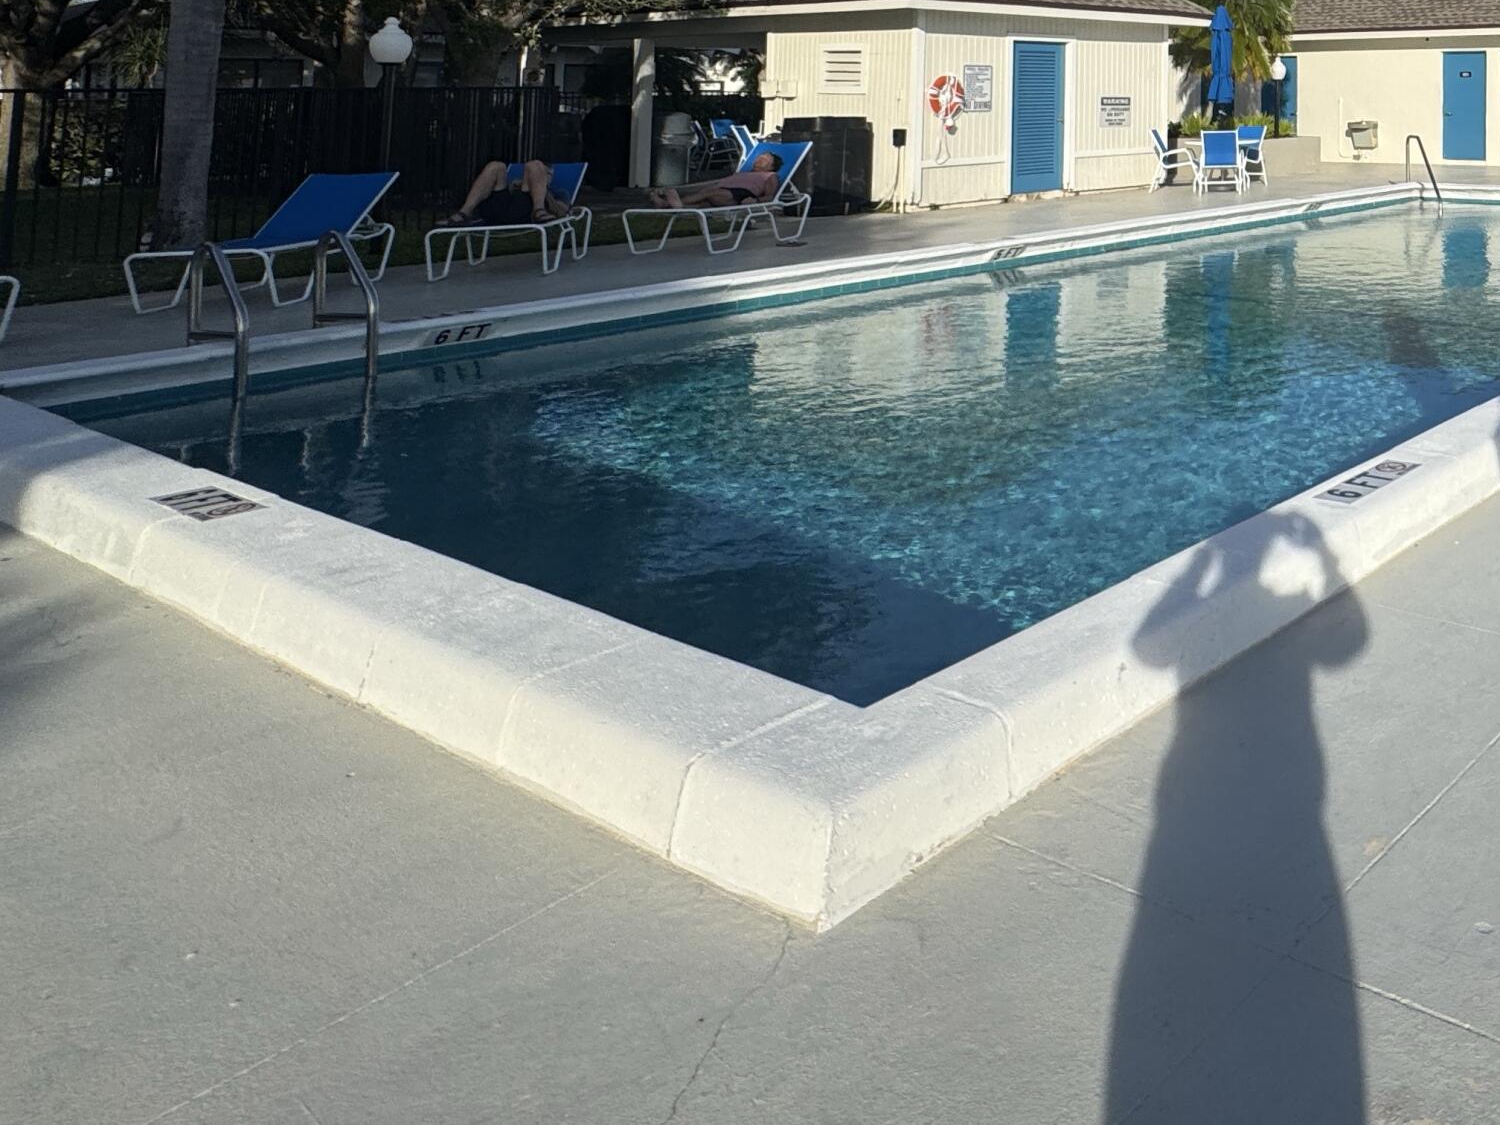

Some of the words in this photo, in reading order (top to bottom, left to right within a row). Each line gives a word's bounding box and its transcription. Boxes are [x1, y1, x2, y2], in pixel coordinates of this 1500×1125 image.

[434, 329, 451, 345] 6
[456, 322, 493, 342] FT
[1343, 471, 1393, 489] FT
[1327, 488, 1363, 499] 6
